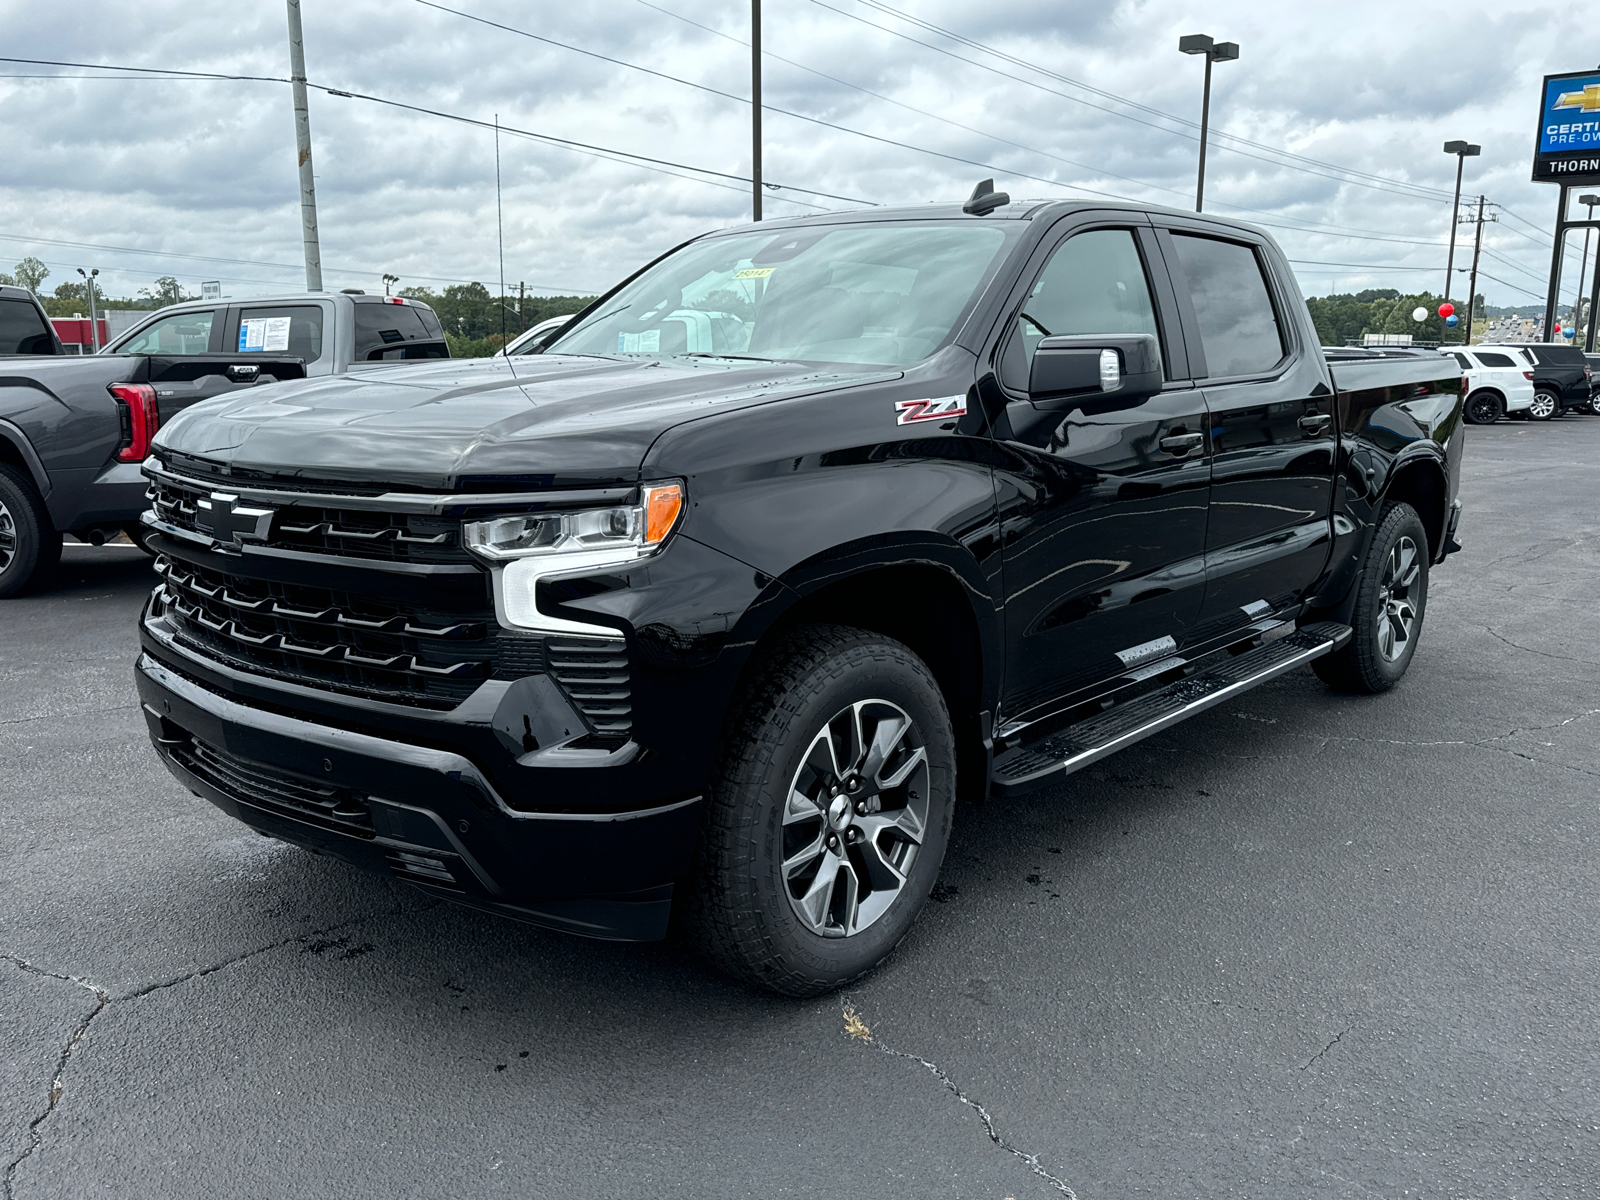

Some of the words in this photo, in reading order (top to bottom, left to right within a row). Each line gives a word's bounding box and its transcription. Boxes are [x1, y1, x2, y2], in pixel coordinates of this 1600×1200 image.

[1546, 121, 1599, 135] CERTI
[1549, 159, 1600, 173] THORN
[894, 393, 967, 426] Z71
